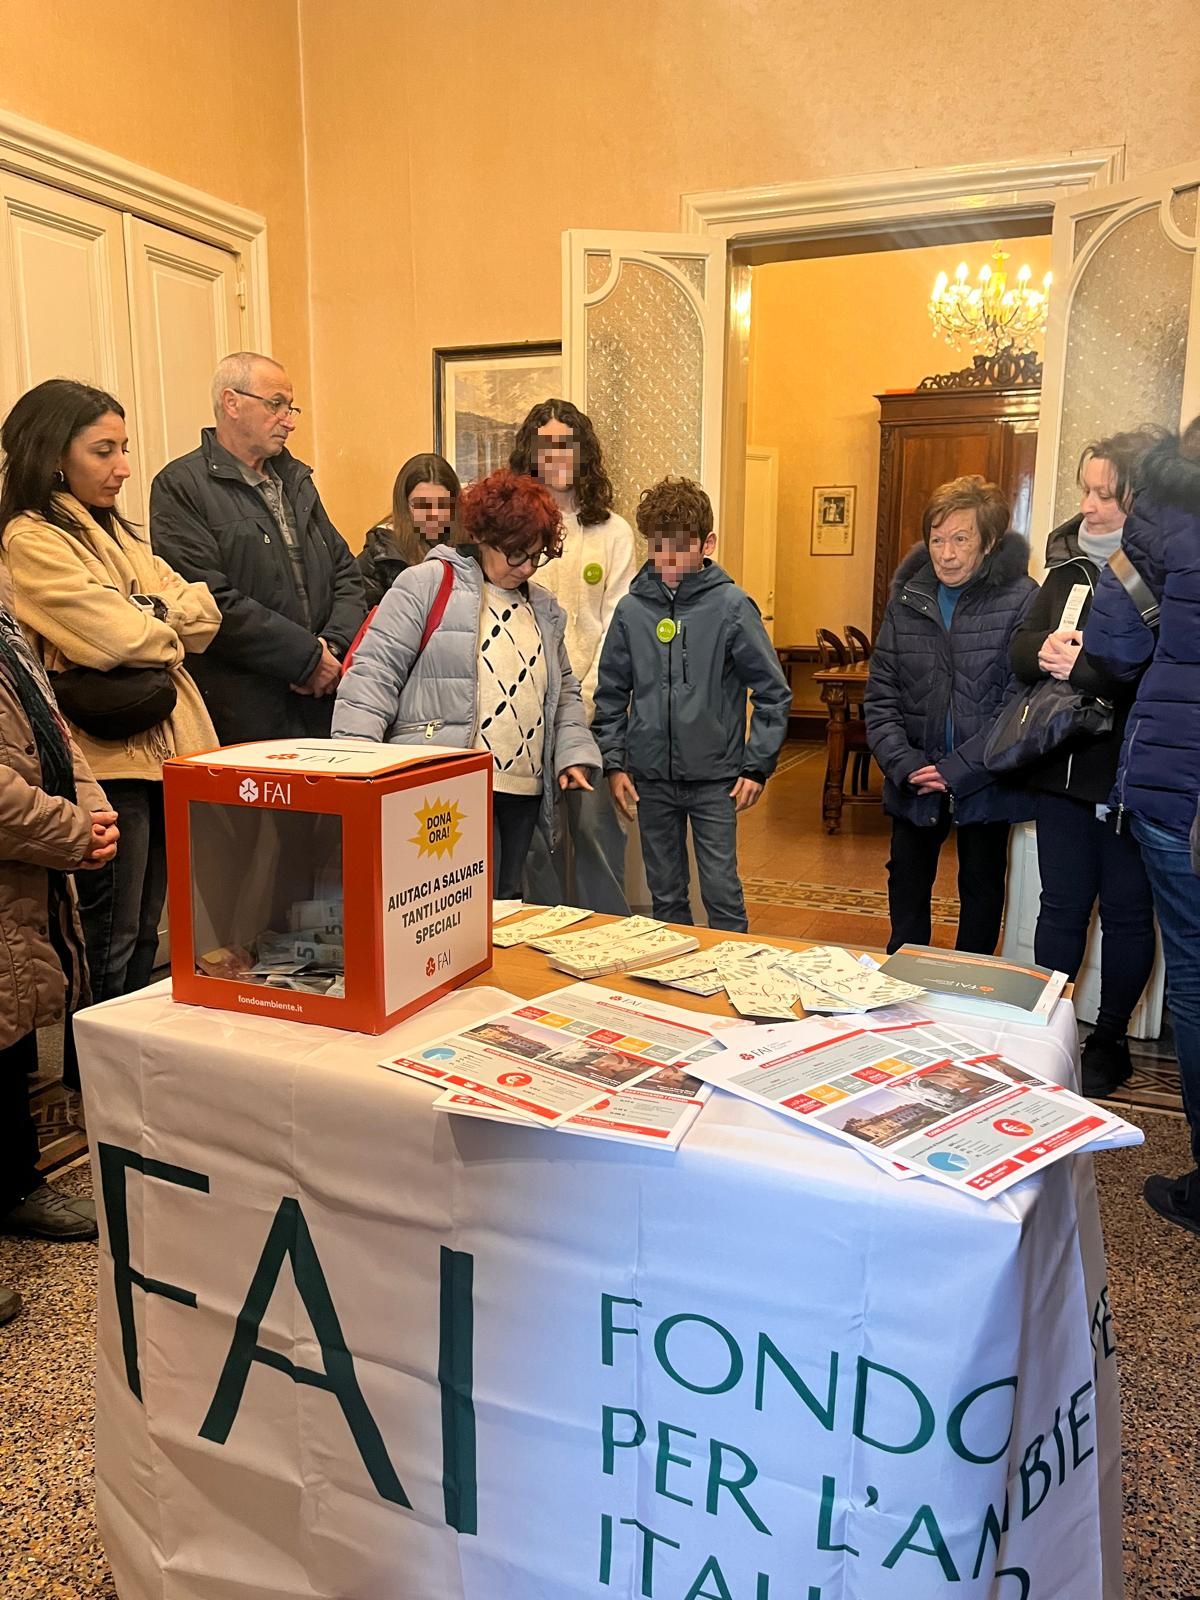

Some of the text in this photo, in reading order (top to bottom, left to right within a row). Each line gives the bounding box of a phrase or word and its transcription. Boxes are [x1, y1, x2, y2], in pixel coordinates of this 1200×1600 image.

[263, 781, 291, 805] FAI
[426, 811, 452, 830] DONA
[428, 825, 450, 844] ORA!
[387, 860, 484, 913] AIUTACI A SALVARE
[401, 885, 473, 929] TANTI LUOGHI
[415, 911, 461, 945] SPECIALI
[437, 948, 452, 971] FAI
[237, 994, 303, 1012] fondoambiente.it
[750, 1045, 773, 1057] FAI
[97, 1141, 478, 1536] FAI
[601, 1292, 1019, 1465] FONDO
[601, 1404, 773, 1536] PER
